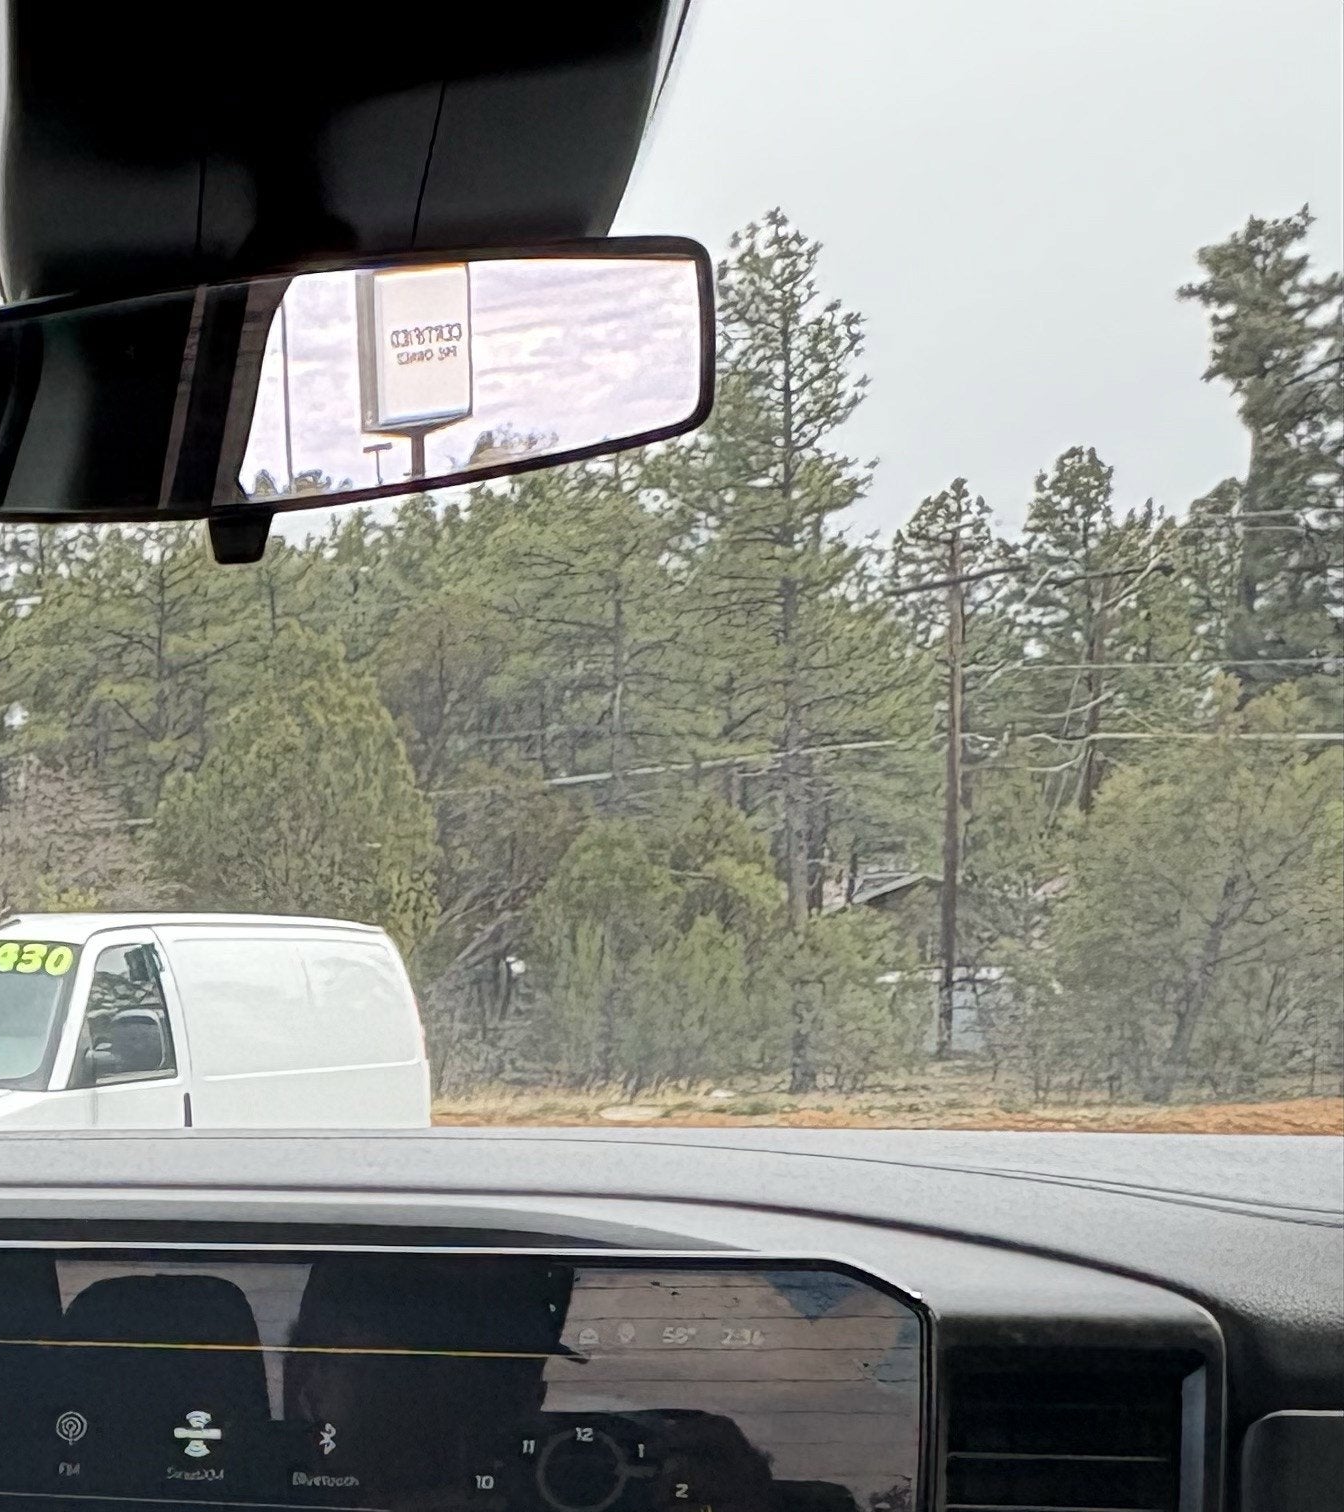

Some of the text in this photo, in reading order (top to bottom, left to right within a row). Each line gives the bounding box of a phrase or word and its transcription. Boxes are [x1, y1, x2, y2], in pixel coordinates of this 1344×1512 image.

[575, 1427, 593, 1442] 12
[522, 1440, 535, 1454] 11
[637, 1443, 645, 1458] 1
[475, 1474, 494, 1490] 10
[675, 1483, 689, 1498] 2
